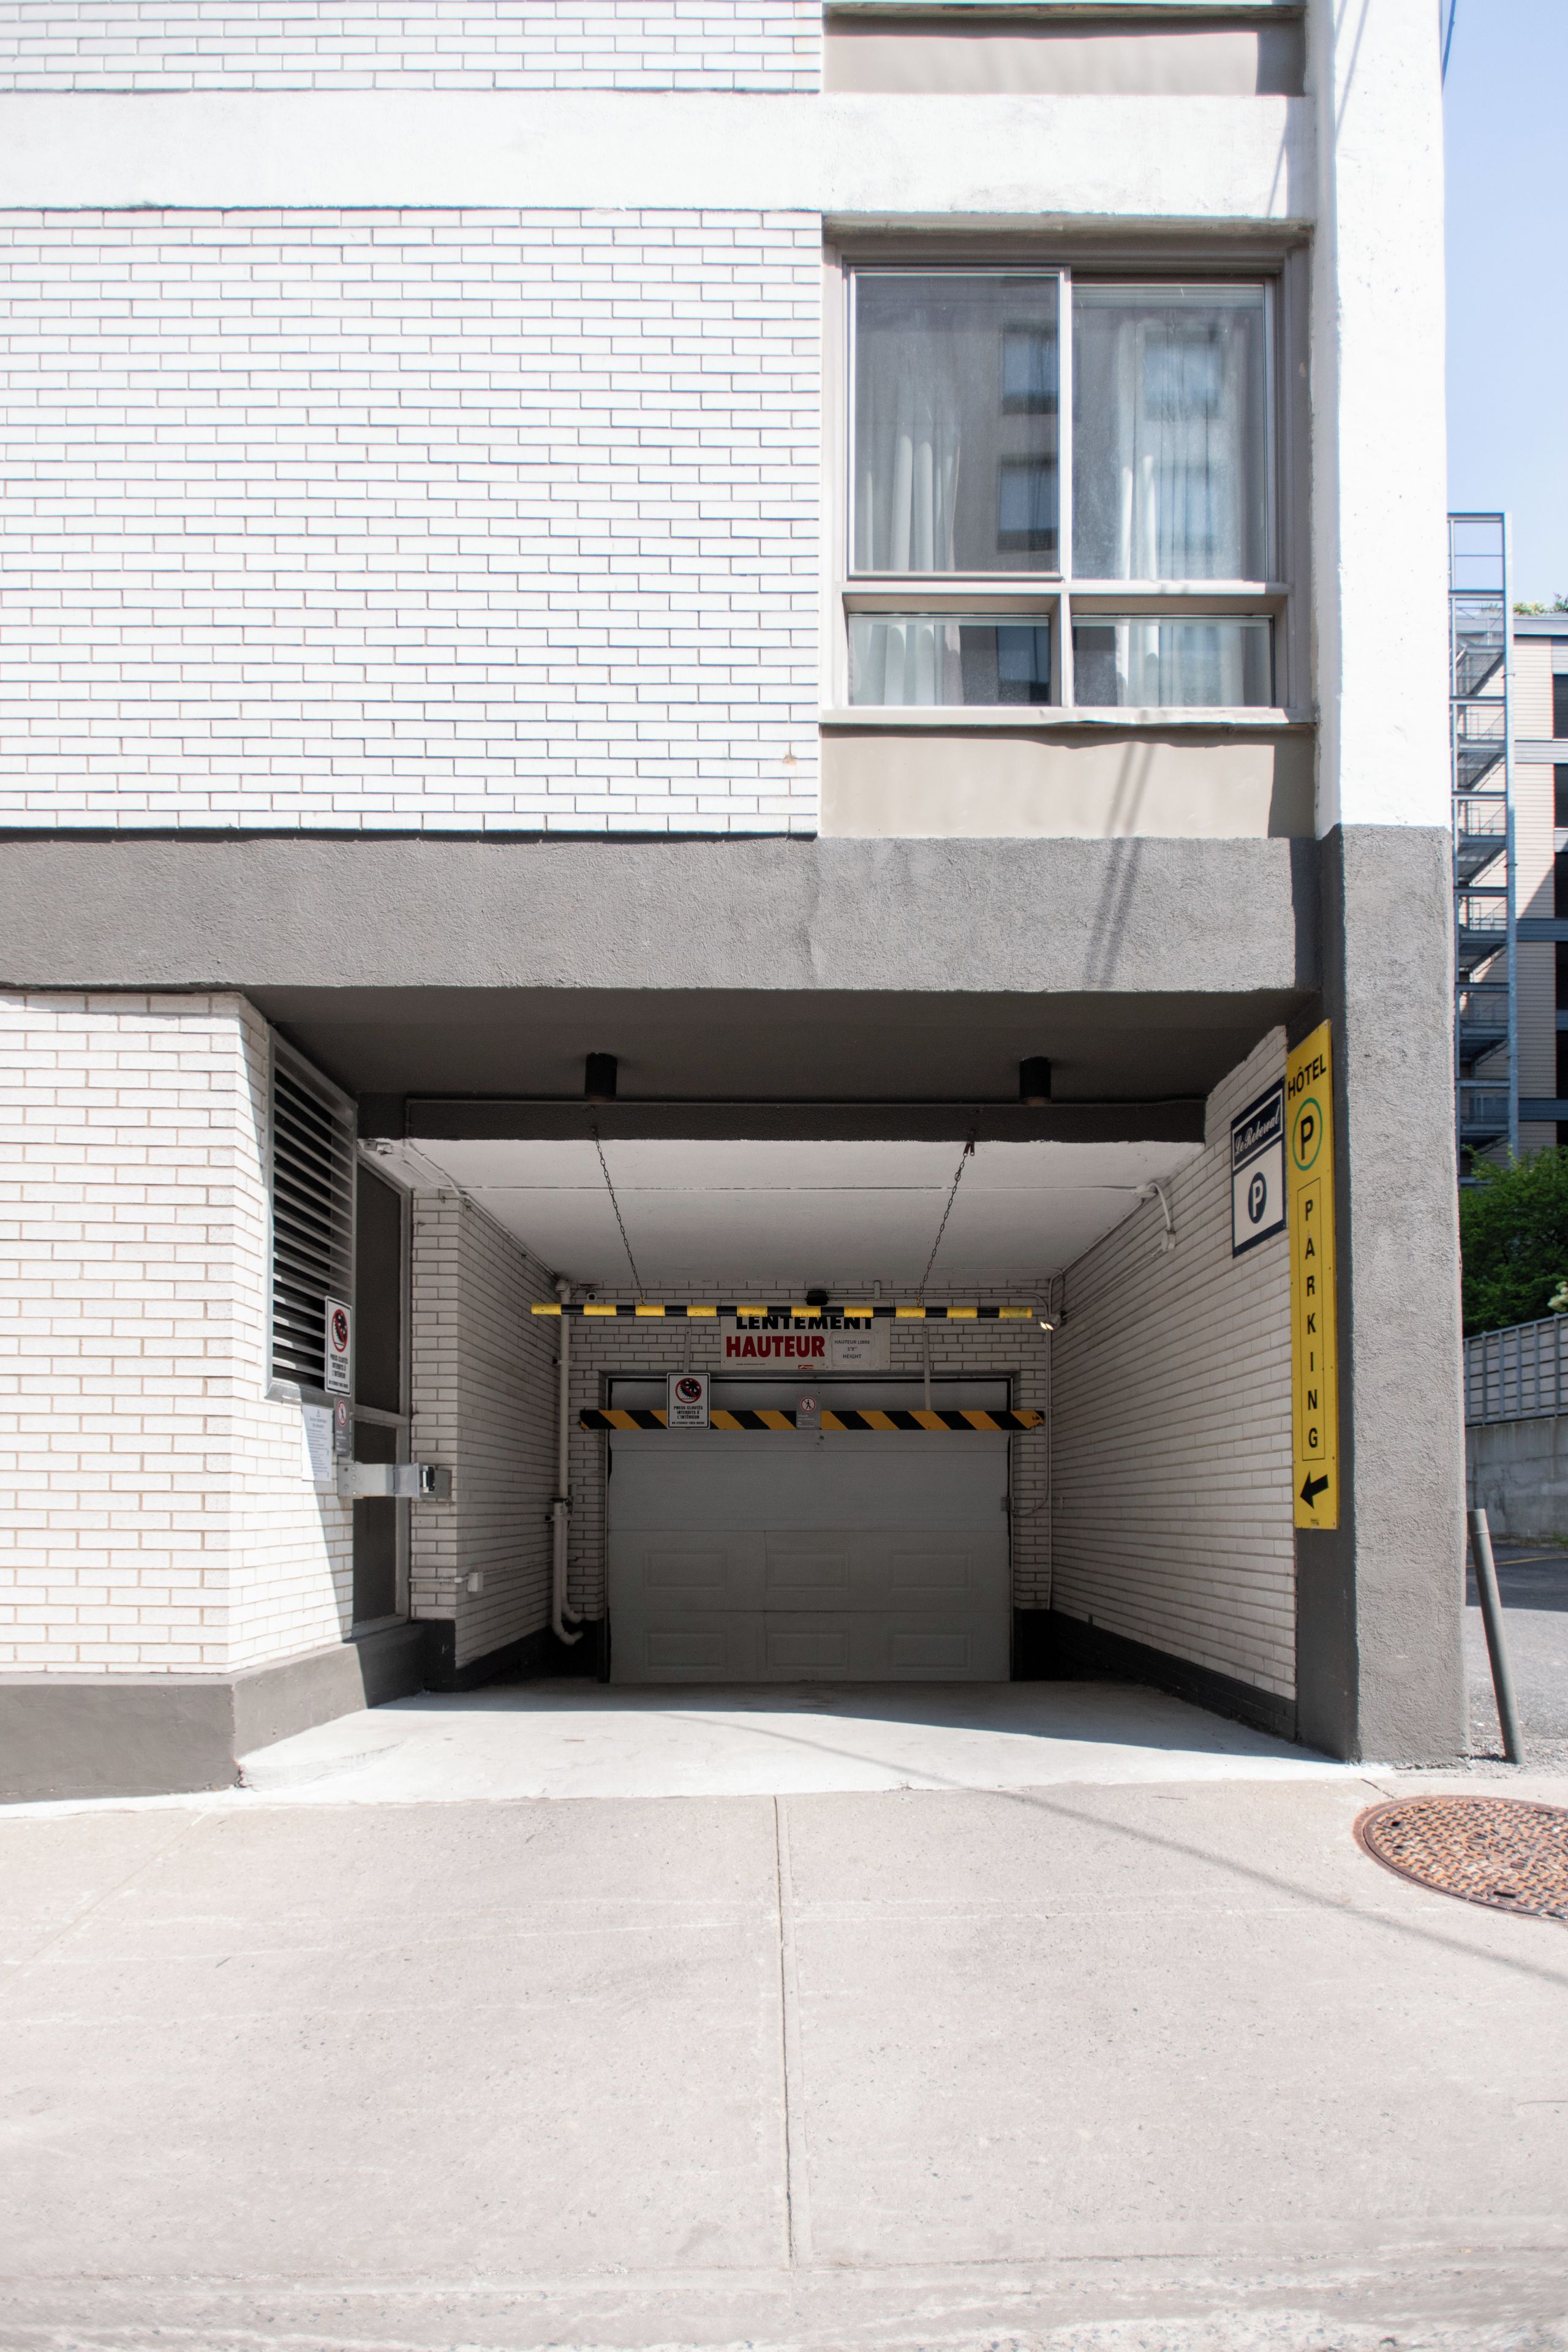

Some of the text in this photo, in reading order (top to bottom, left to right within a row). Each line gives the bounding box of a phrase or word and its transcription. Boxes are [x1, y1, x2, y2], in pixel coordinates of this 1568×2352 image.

[1288, 1054, 1327, 1100] HÔTEL
[1235, 1104, 1280, 1156] Le Roberval
[1301, 1115, 1314, 1161] P
[1252, 1179, 1264, 1218] P
[736, 1316, 874, 1330] LENTEMENT
[1305, 1199, 1318, 1449] PARKING
[726, 1336, 825, 1357] HAUTEUR
